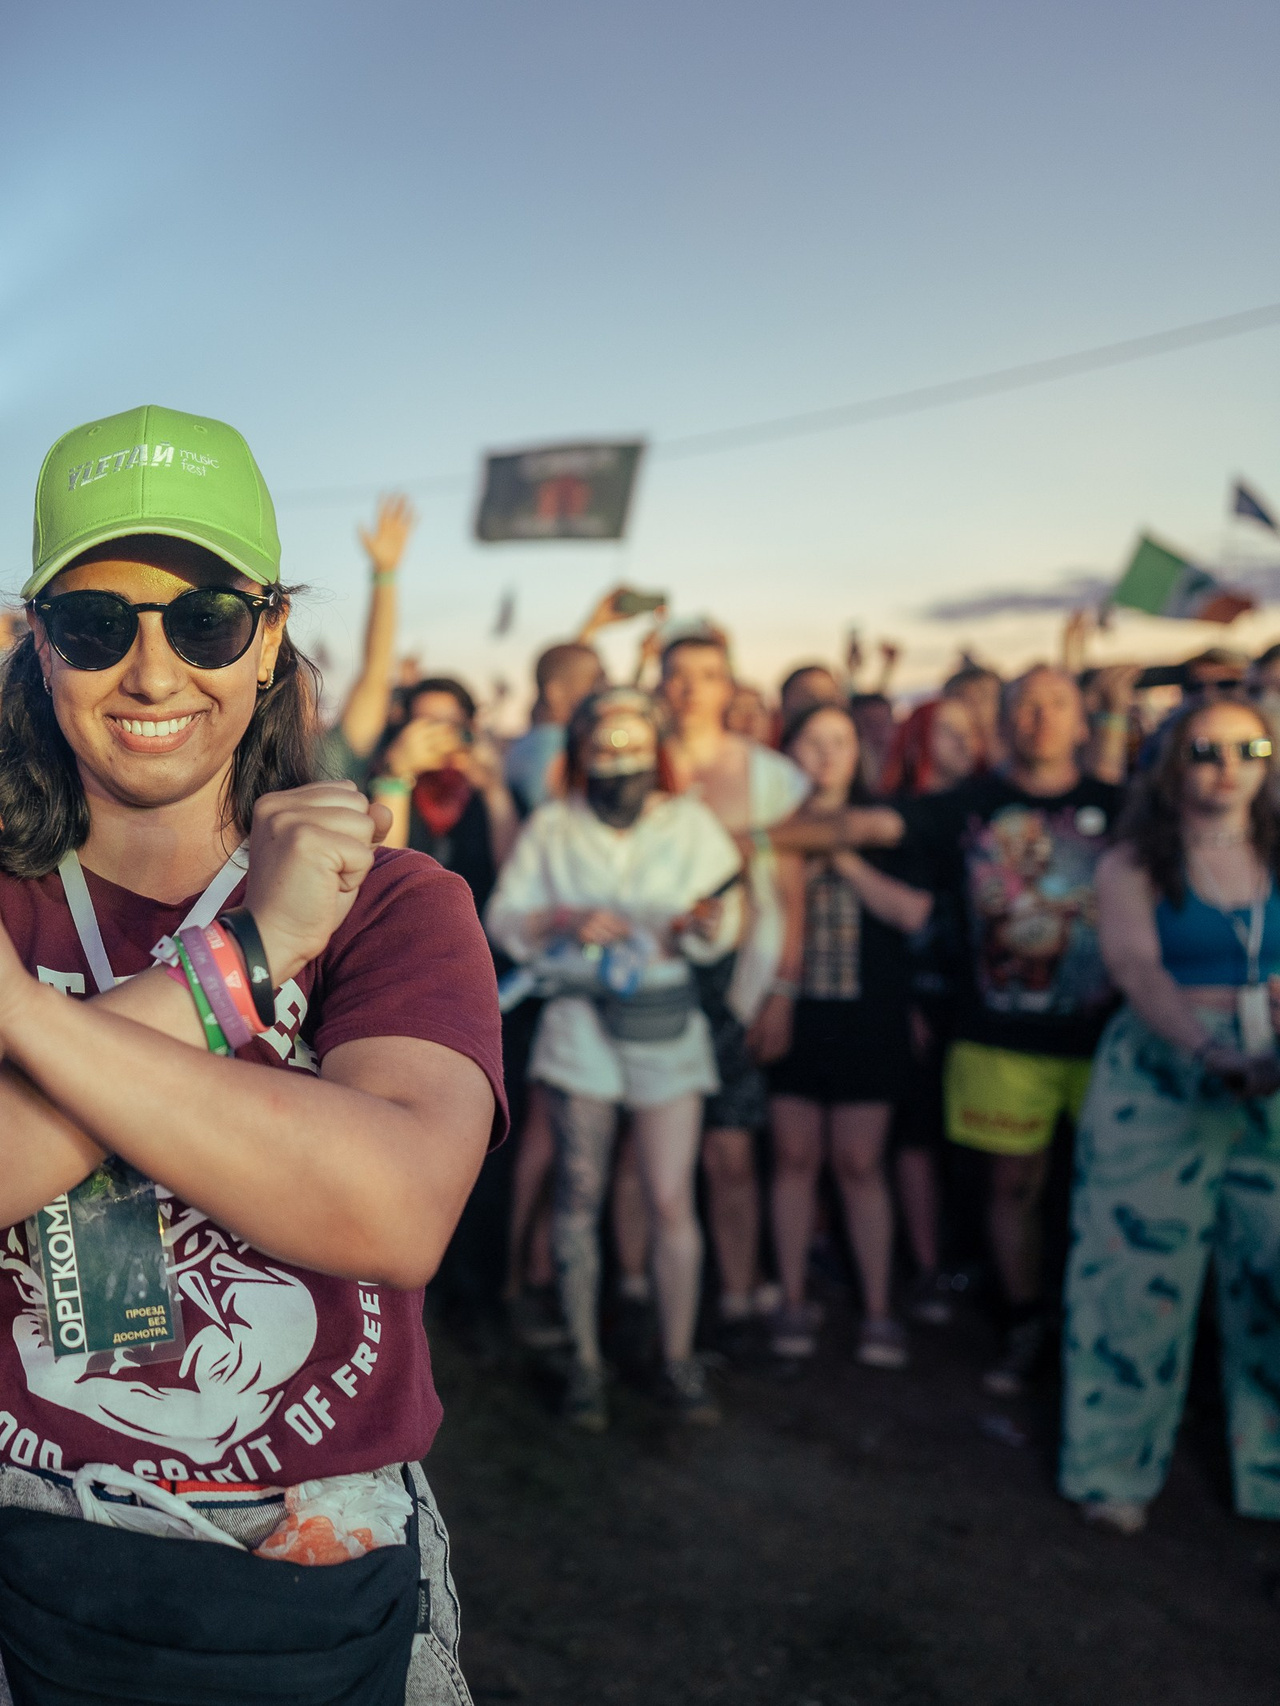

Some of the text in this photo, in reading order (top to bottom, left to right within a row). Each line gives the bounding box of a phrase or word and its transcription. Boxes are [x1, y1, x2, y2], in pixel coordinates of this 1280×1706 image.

[180, 449, 220, 469] music
[181, 458, 207, 477] fest
[125, 1304, 166, 1319] ПРОЕЗД
[148, 1315, 167, 1327] БЕЗ
[113, 1326, 168, 1344] ДОСМОТРА
[133, 1434, 282, 1484] SPRIT
[284, 1384, 336, 1446] OF
[331, 1280, 382, 1399] FREE
